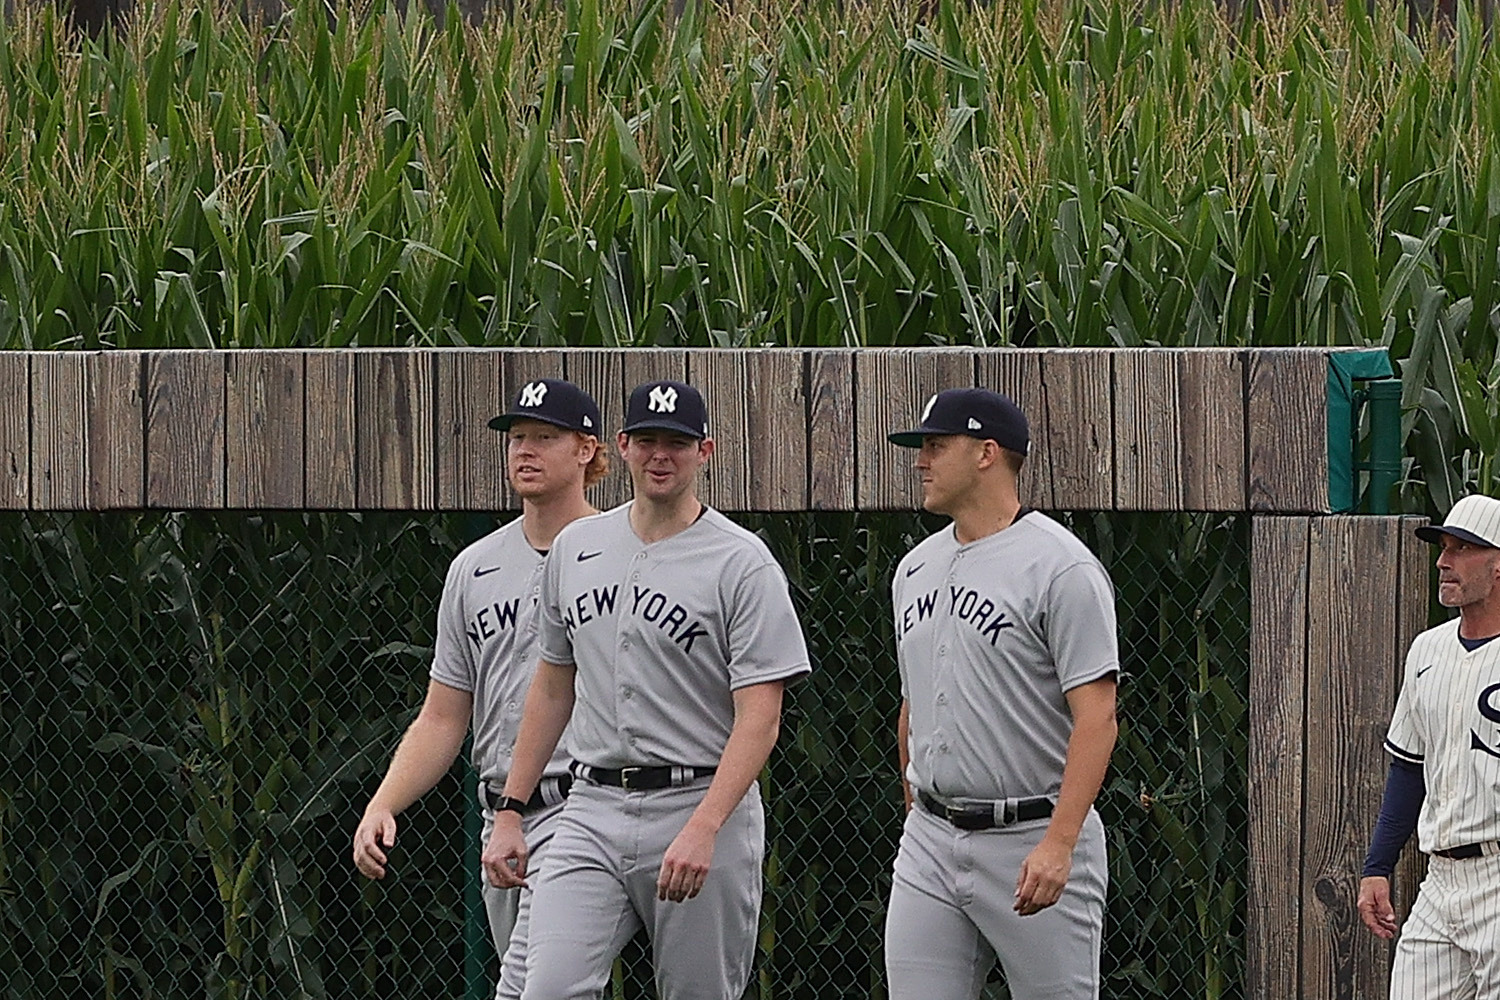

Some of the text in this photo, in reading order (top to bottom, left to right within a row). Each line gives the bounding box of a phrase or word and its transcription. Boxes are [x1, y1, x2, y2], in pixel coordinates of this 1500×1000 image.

[519, 382, 548, 407] NY
[648, 385, 678, 413] NY
[466, 598, 521, 655] NEW
[564, 584, 709, 655] NEW YORK
[899, 585, 1015, 647] EW YORK
